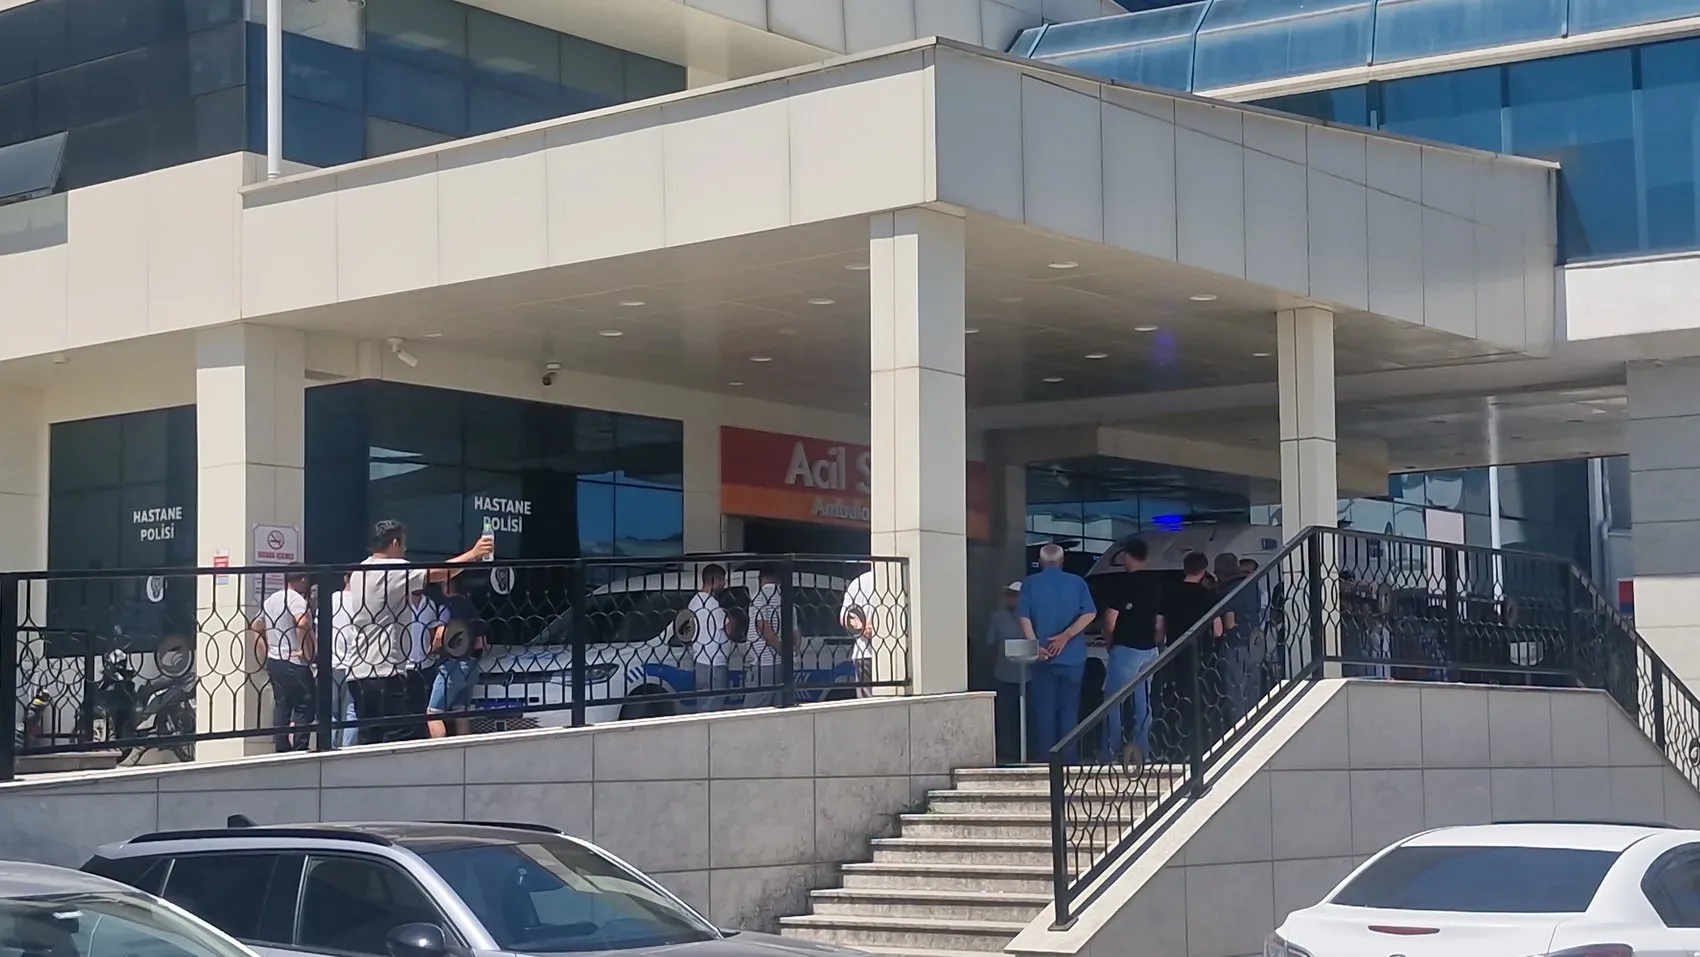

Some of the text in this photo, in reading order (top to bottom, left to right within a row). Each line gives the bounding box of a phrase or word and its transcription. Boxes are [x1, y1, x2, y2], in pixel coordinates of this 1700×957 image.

[784, 441, 846, 490] Acil
[474, 496, 531, 514] HASTANE
[133, 506, 182, 524] HASTANE
[140, 523, 175, 542] POLİSİ
